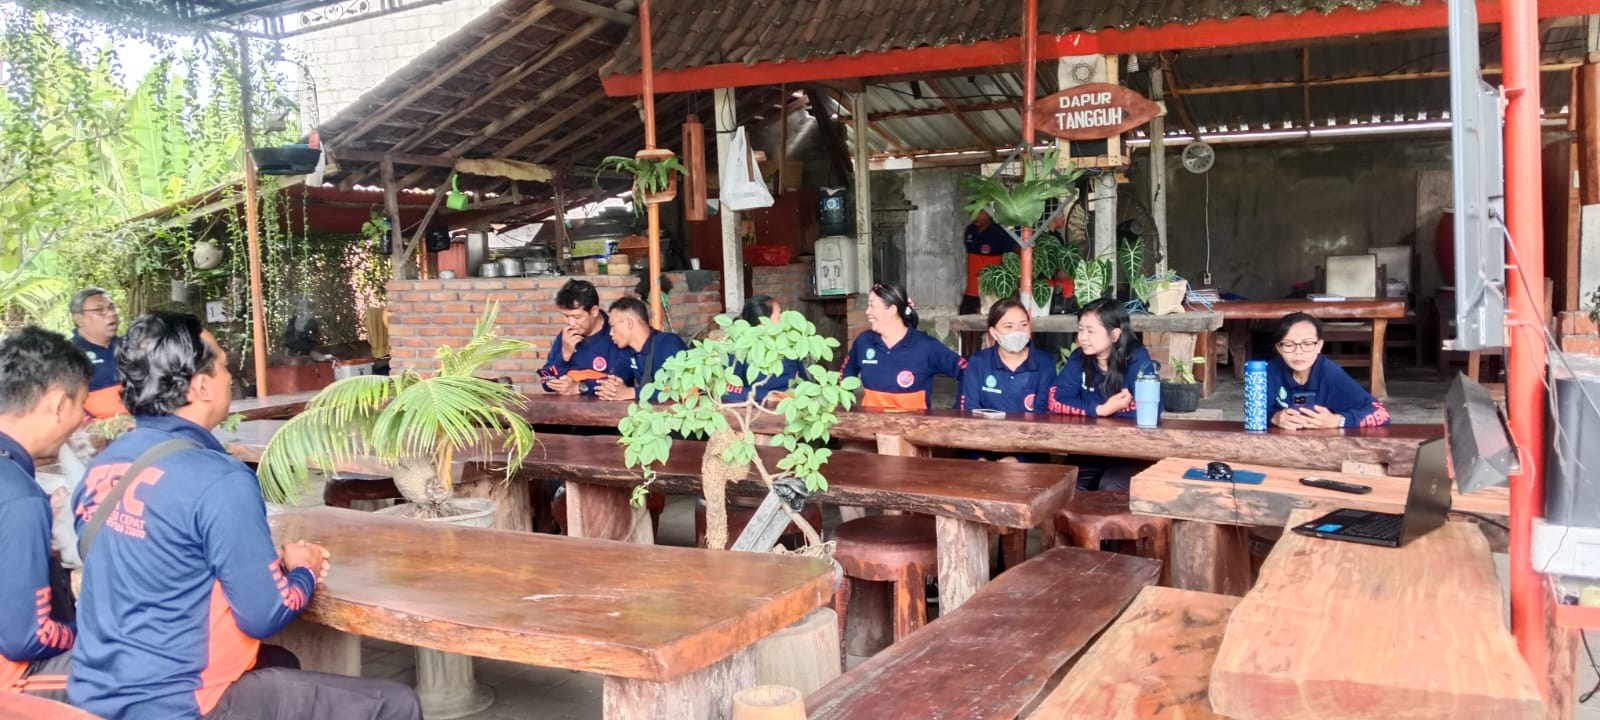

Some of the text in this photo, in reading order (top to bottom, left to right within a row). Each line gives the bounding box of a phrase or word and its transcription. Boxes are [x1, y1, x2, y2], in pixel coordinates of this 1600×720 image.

[1059, 91, 1112, 109] DAPUR
[1055, 107, 1122, 130] TANGGUH
[120, 513, 146, 530] CEPAT
